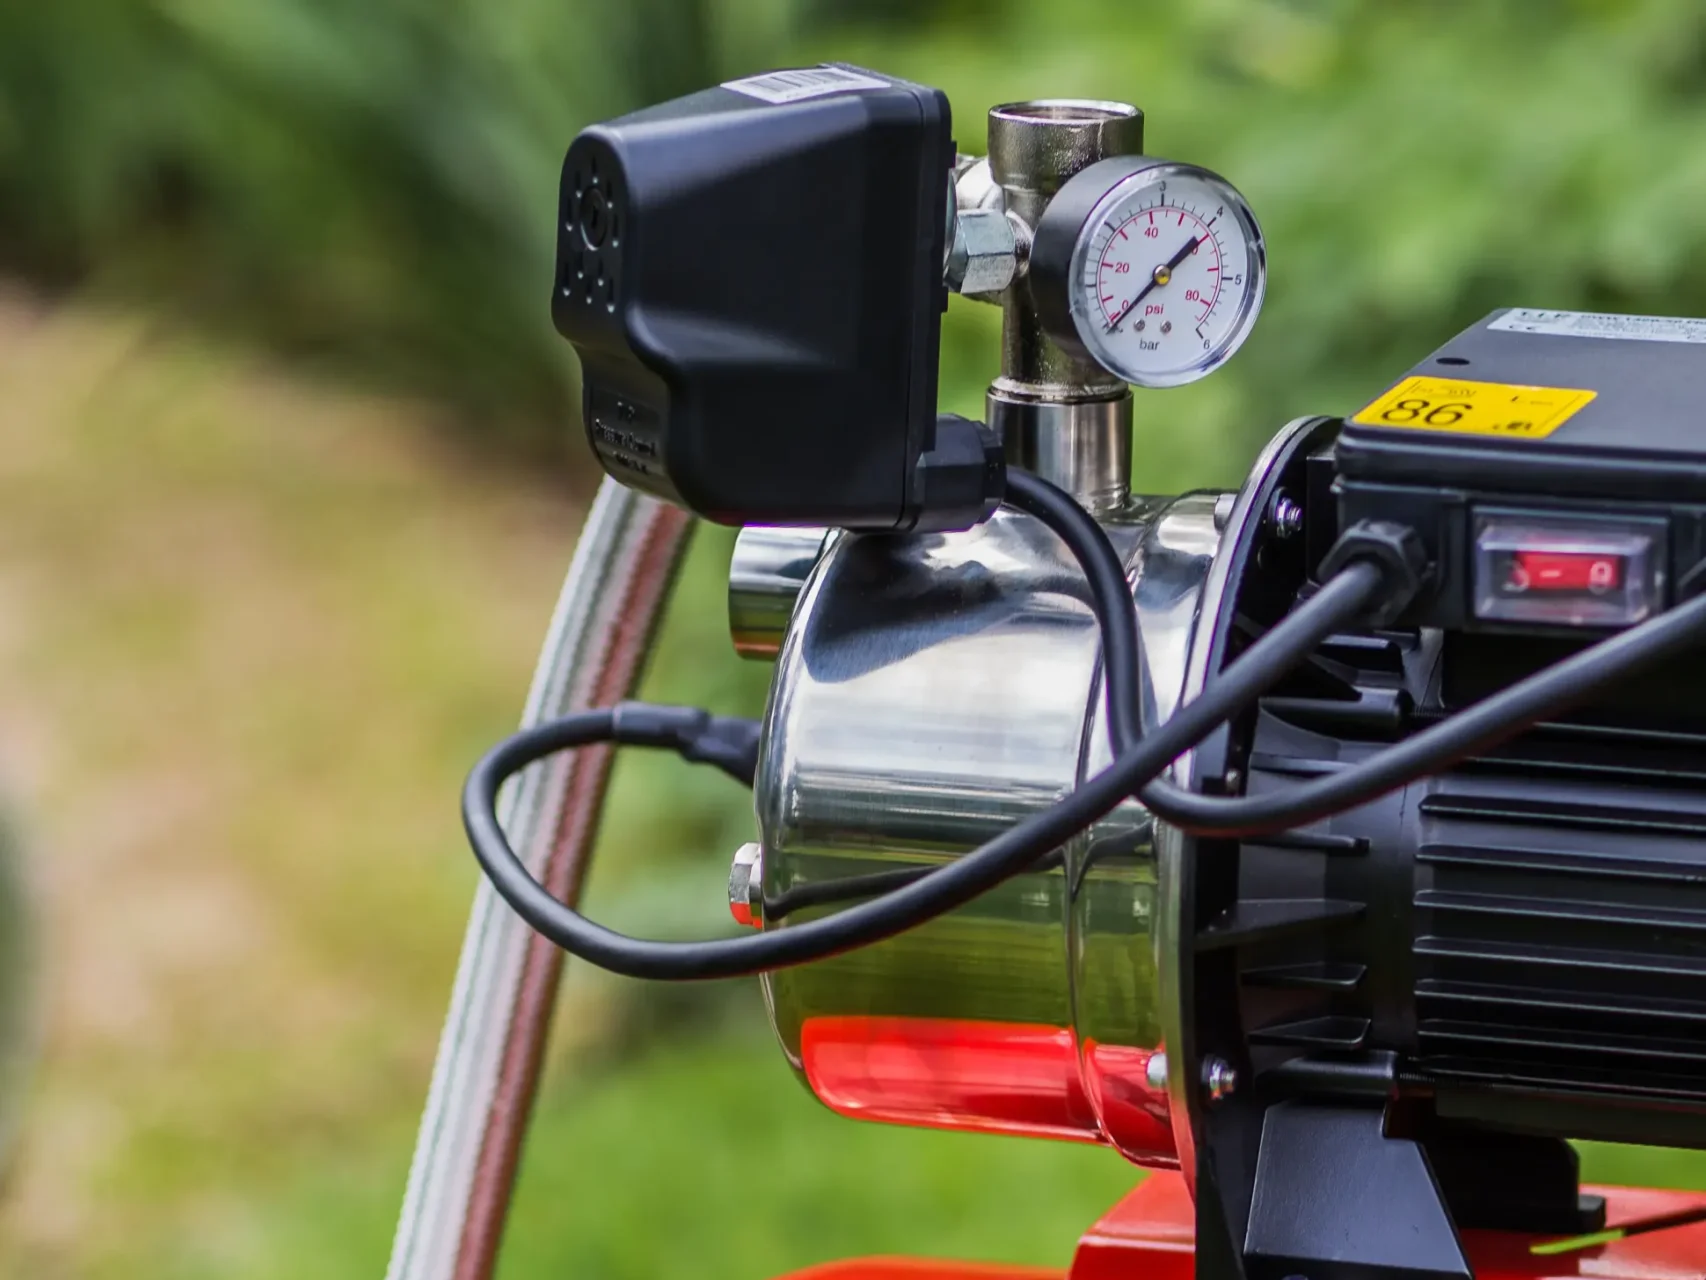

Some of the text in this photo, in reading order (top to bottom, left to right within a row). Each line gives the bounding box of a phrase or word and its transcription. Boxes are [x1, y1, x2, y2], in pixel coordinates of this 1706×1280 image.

[1158, 181, 1168, 192] 3
[1216, 205, 1224, 217] 4
[1143, 227, 1159, 239] 40
[1115, 262, 1130, 274] 20
[1234, 274, 1243, 286] 5
[1185, 290, 1200, 302] 80
[1145, 303, 1164, 317] psi
[1139, 336, 1161, 351] bar
[1203, 339, 1211, 350] 6
[1381, 398, 1474, 427] 86
